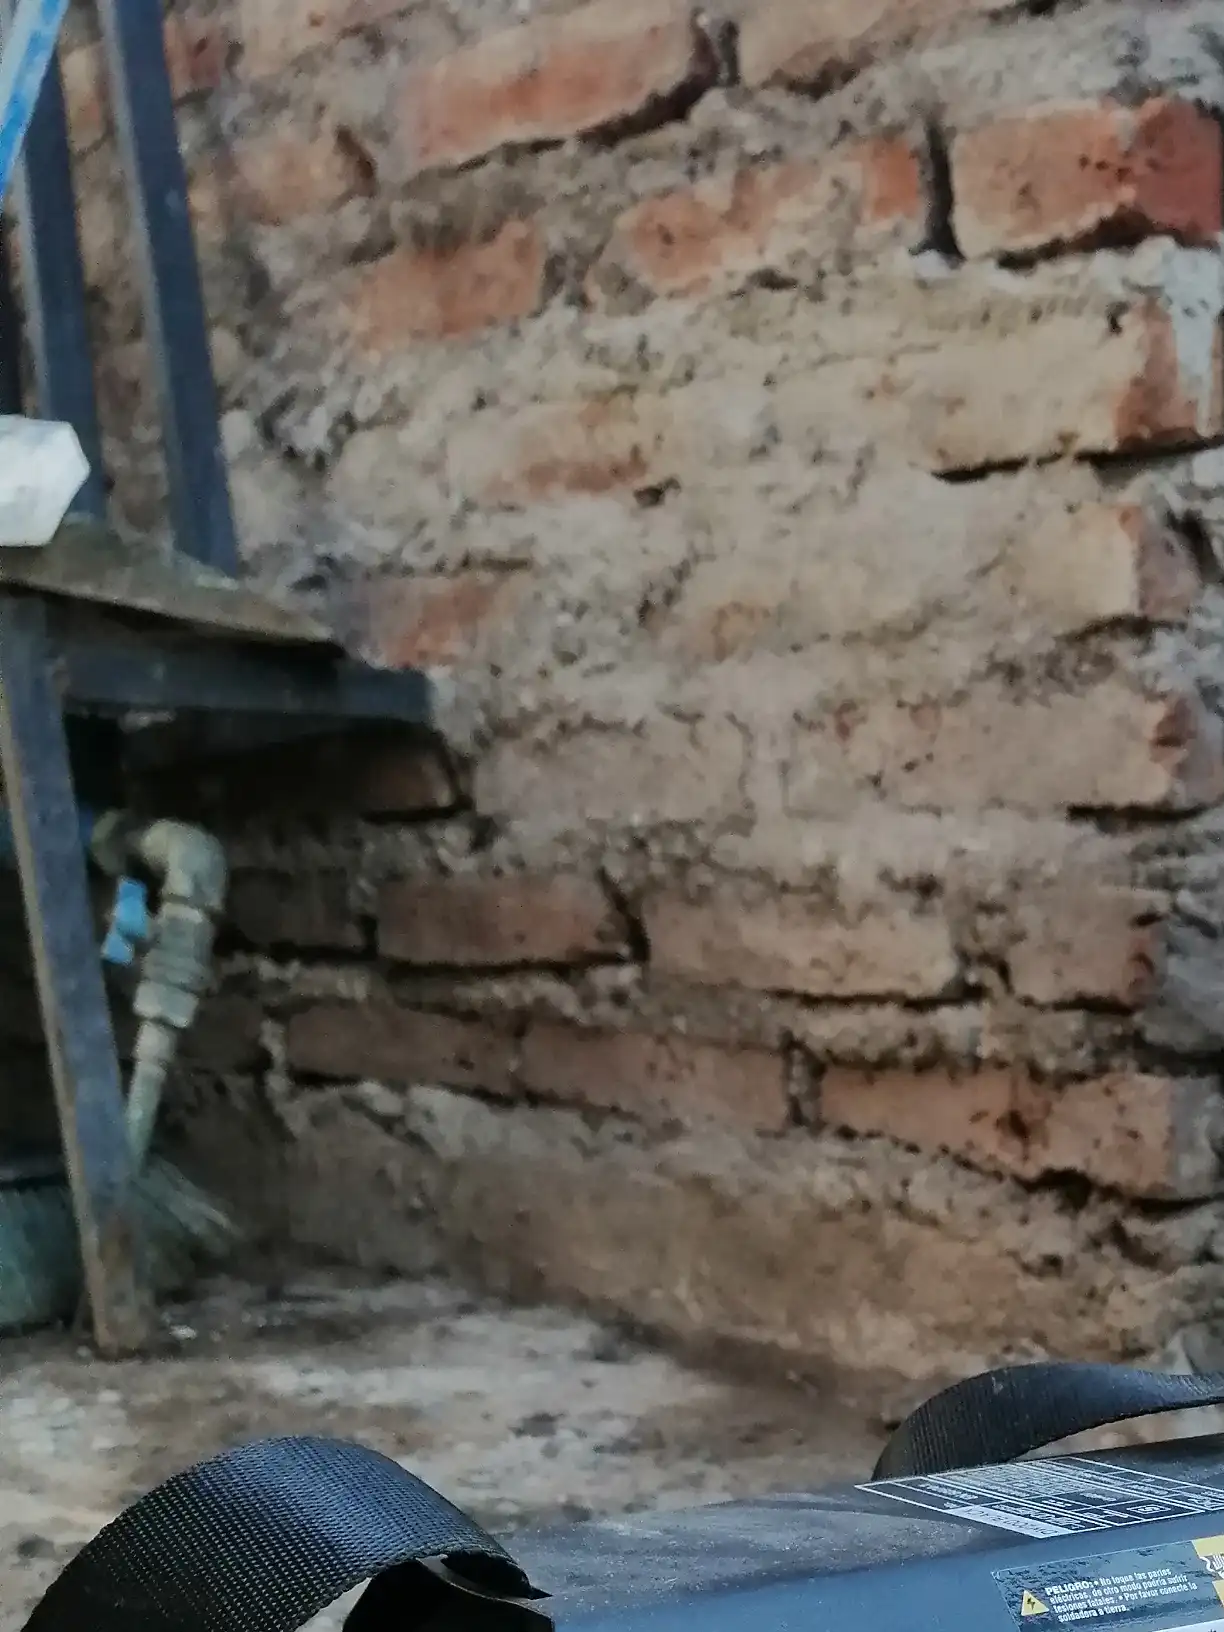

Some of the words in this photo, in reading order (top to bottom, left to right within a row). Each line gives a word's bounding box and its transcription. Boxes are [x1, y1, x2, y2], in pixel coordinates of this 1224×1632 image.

[1044, 1580, 1093, 1595] PELIGRO:
[1103, 1586, 1119, 1595] otro
[1119, 1582, 1141, 1592] modo
[1123, 1592, 1138, 1601] Por
[1138, 1589, 1158, 1598] favor
[1057, 1609, 1097, 1622] soldadora
